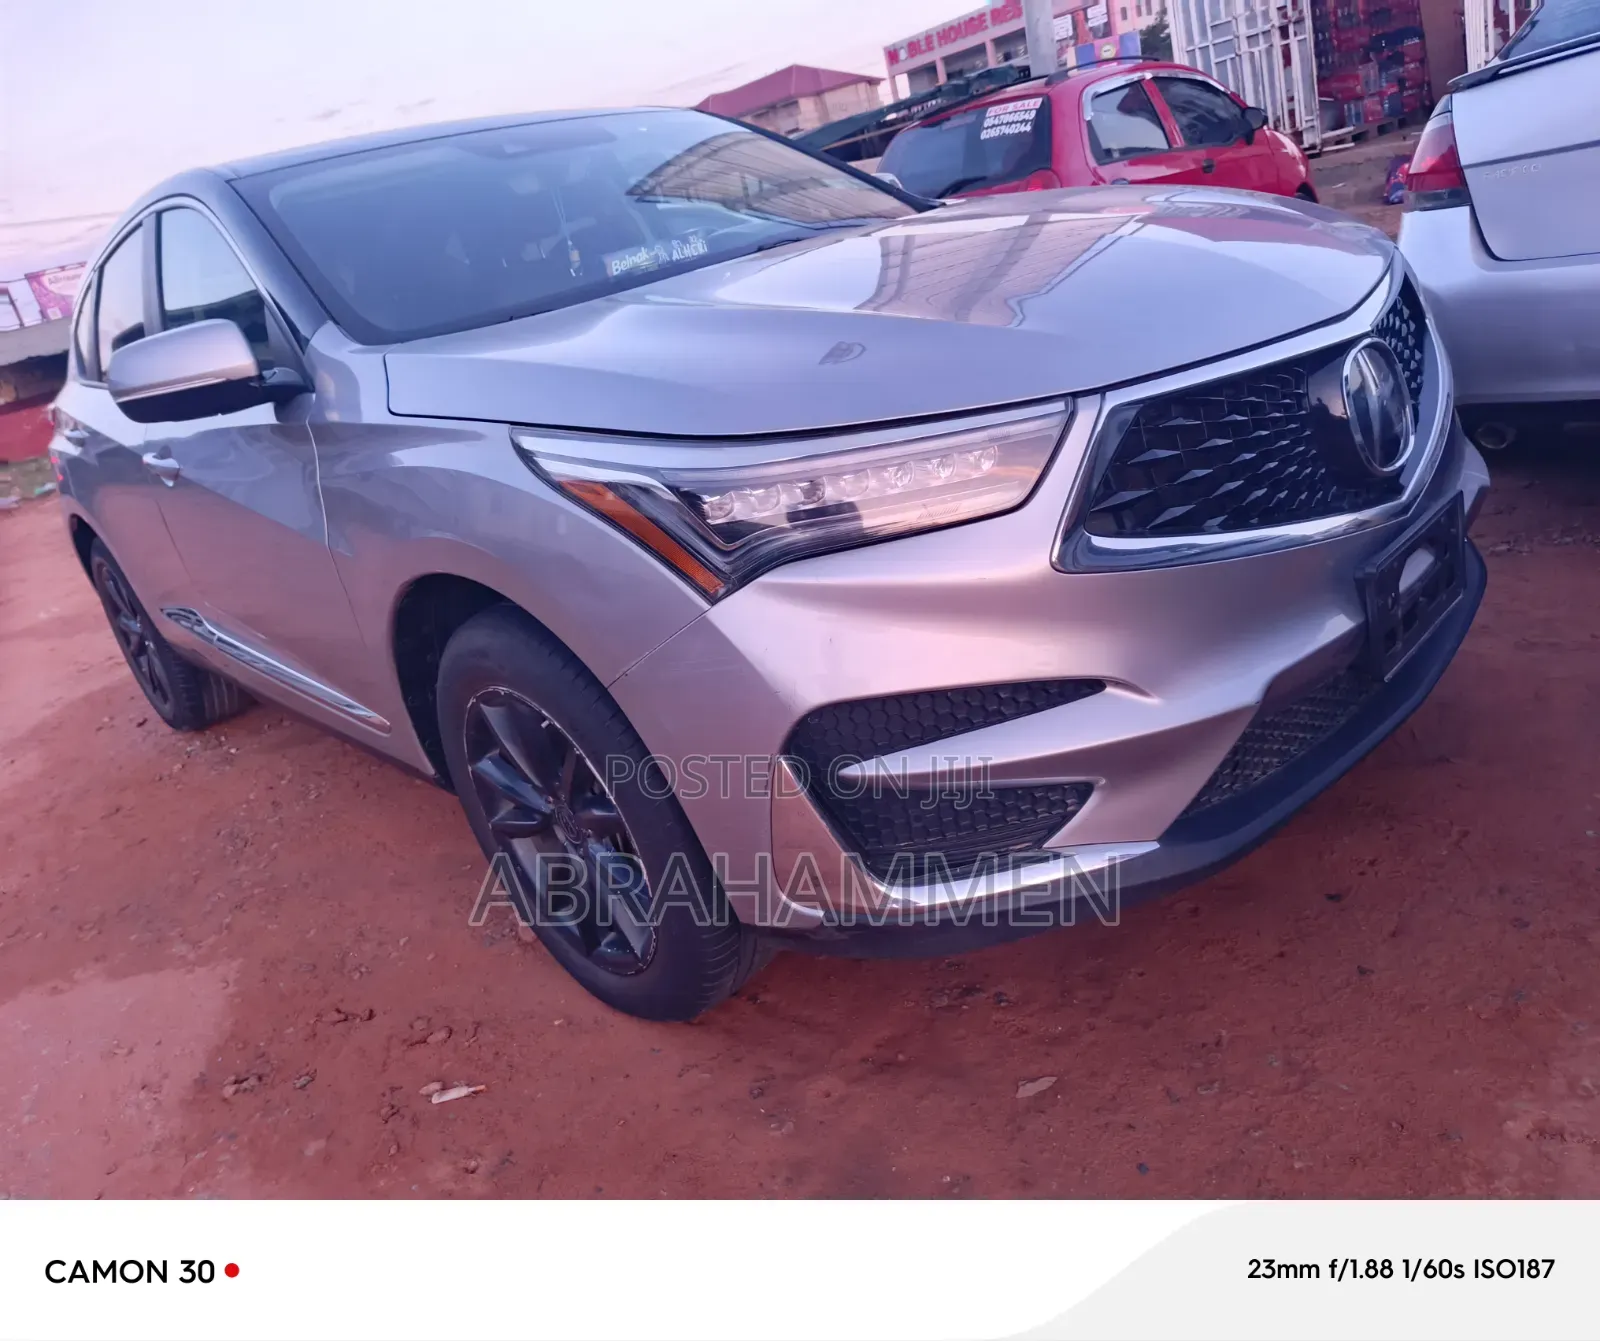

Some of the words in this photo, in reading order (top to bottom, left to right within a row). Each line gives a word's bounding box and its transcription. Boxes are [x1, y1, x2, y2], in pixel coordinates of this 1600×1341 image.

[936, 12, 989, 48] HOUSE
[987, 105, 1010, 116] FOR
[1012, 98, 1041, 110] SALE
